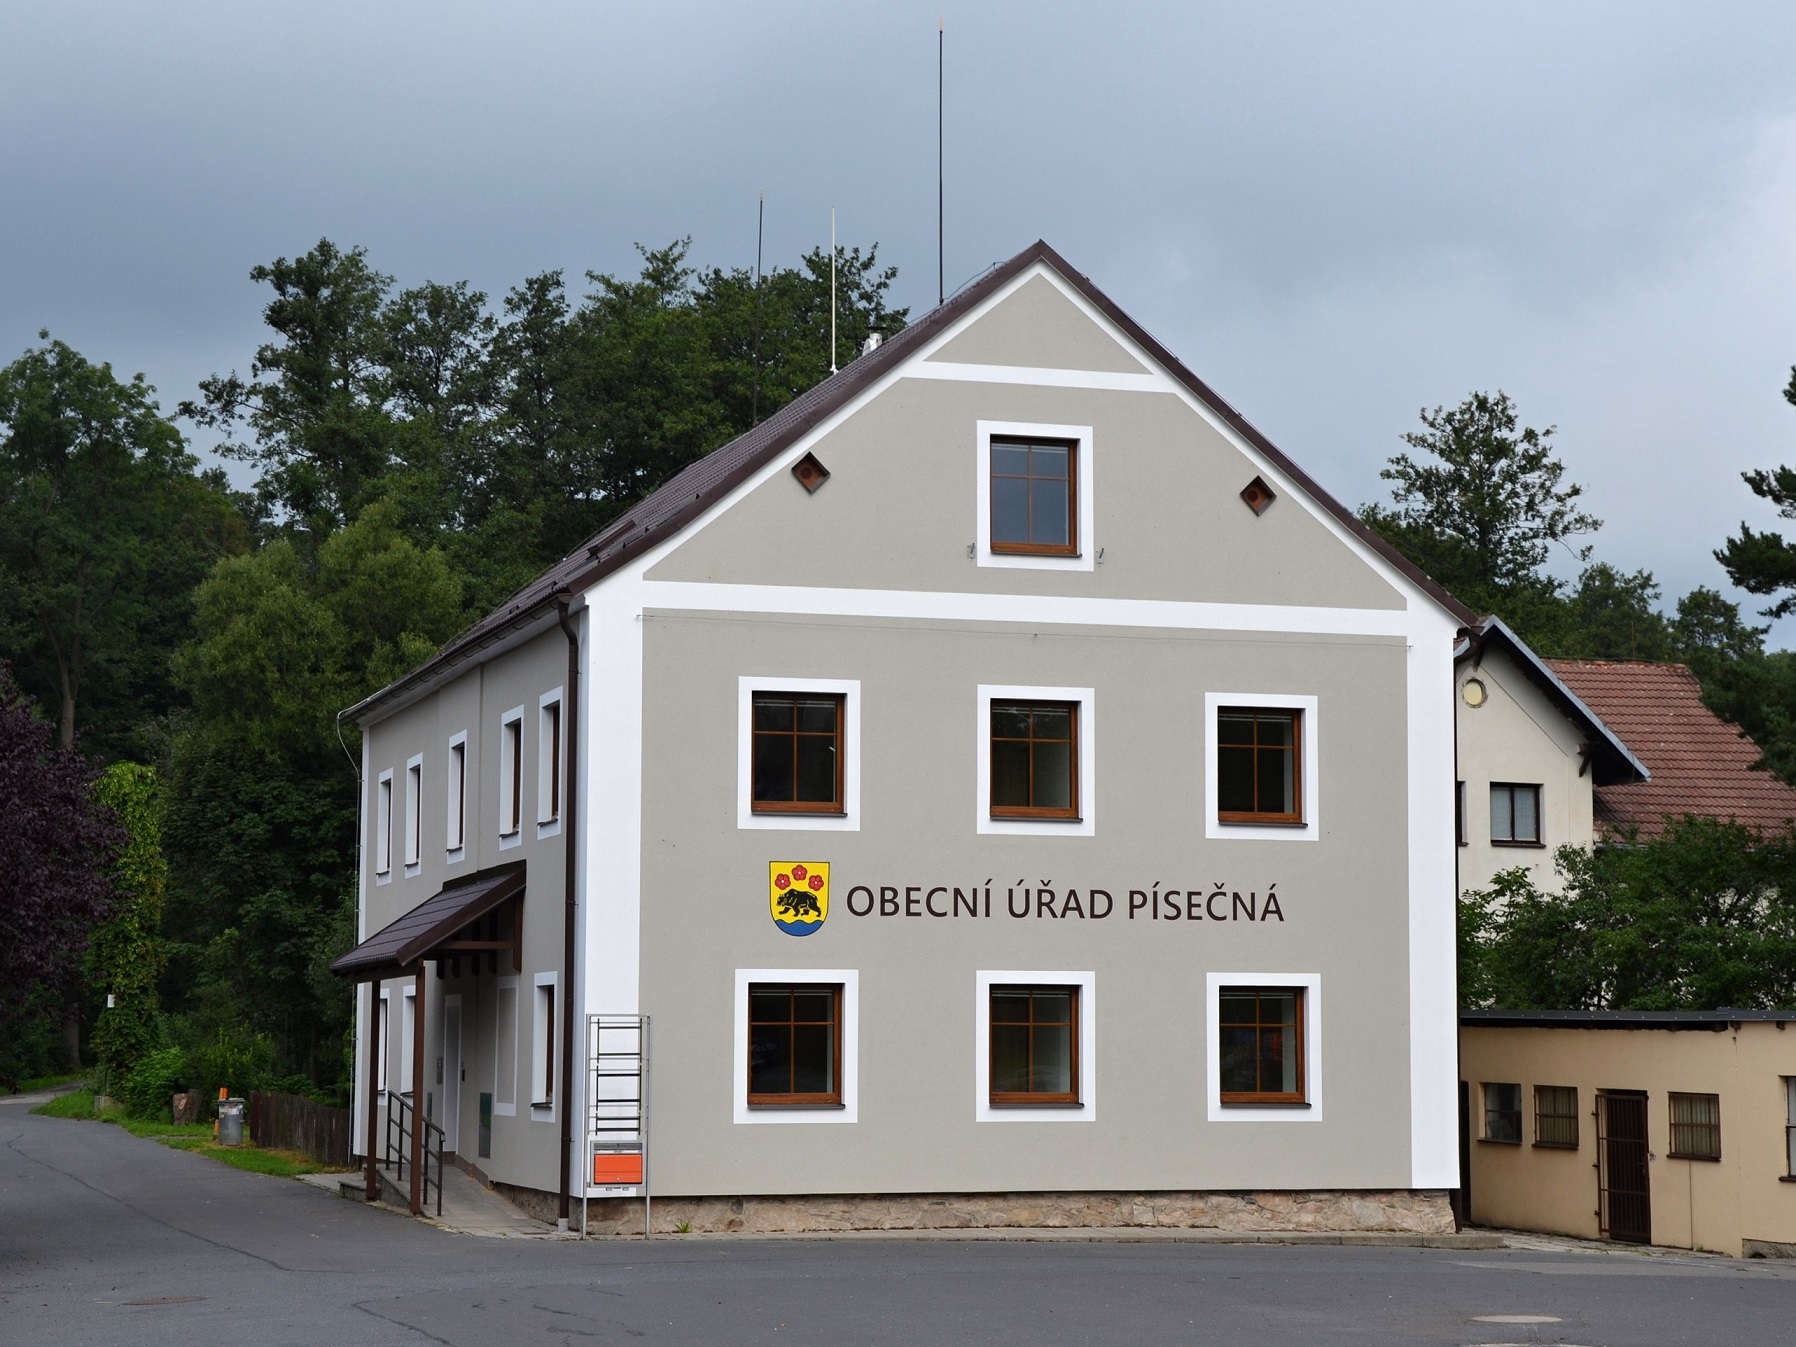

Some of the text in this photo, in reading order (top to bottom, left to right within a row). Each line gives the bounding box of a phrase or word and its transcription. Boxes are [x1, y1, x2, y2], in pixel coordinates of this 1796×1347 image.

[846, 878, 1285, 922] OBECNÍ ÚŘAD PÍSEČNÁ
